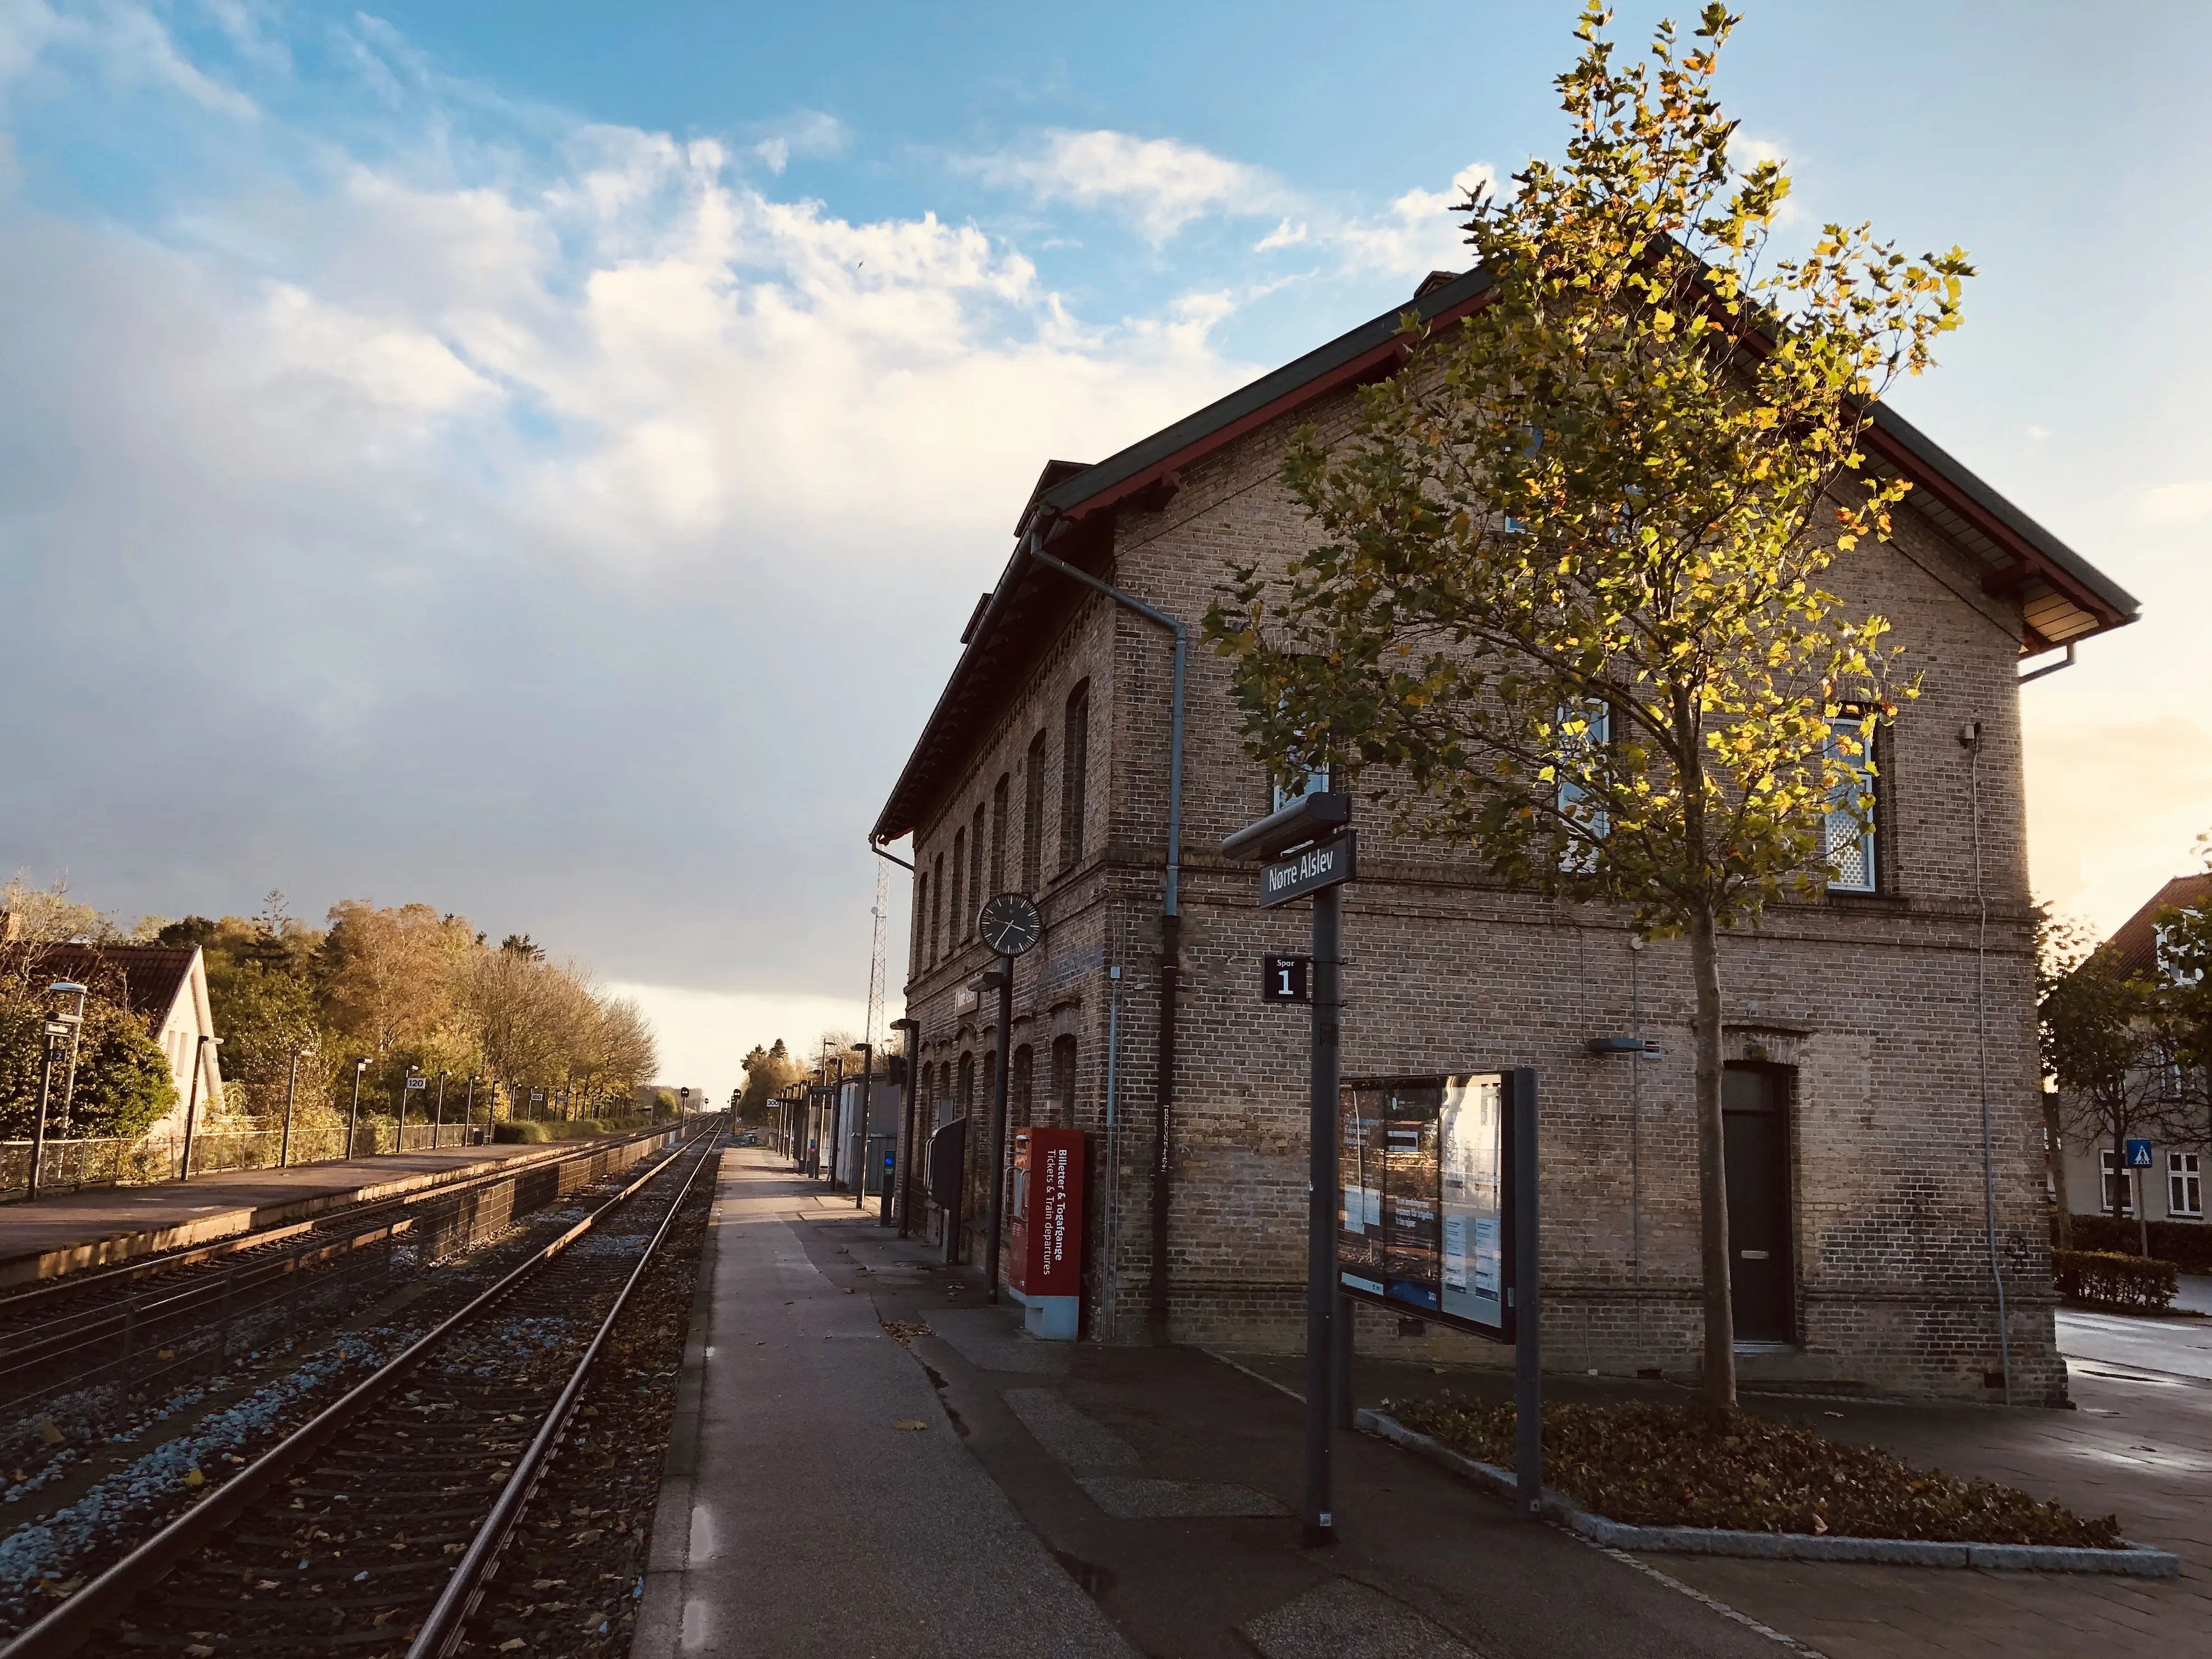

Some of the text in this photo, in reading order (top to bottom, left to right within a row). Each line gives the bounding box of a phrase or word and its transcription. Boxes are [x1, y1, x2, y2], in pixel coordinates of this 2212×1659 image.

[1269, 848, 1334, 893] Nørre Alslev
[1277, 959, 1295, 968] Spor
[1278, 970, 1294, 995] 1
[1046, 1149, 1056, 1183] Tickets
[1058, 1149, 1067, 1190] Billetter
[1045, 1196, 1054, 1220] Train
[1042, 1222, 1054, 1275] departures
[1054, 1202, 1065, 1261] Togafgange
